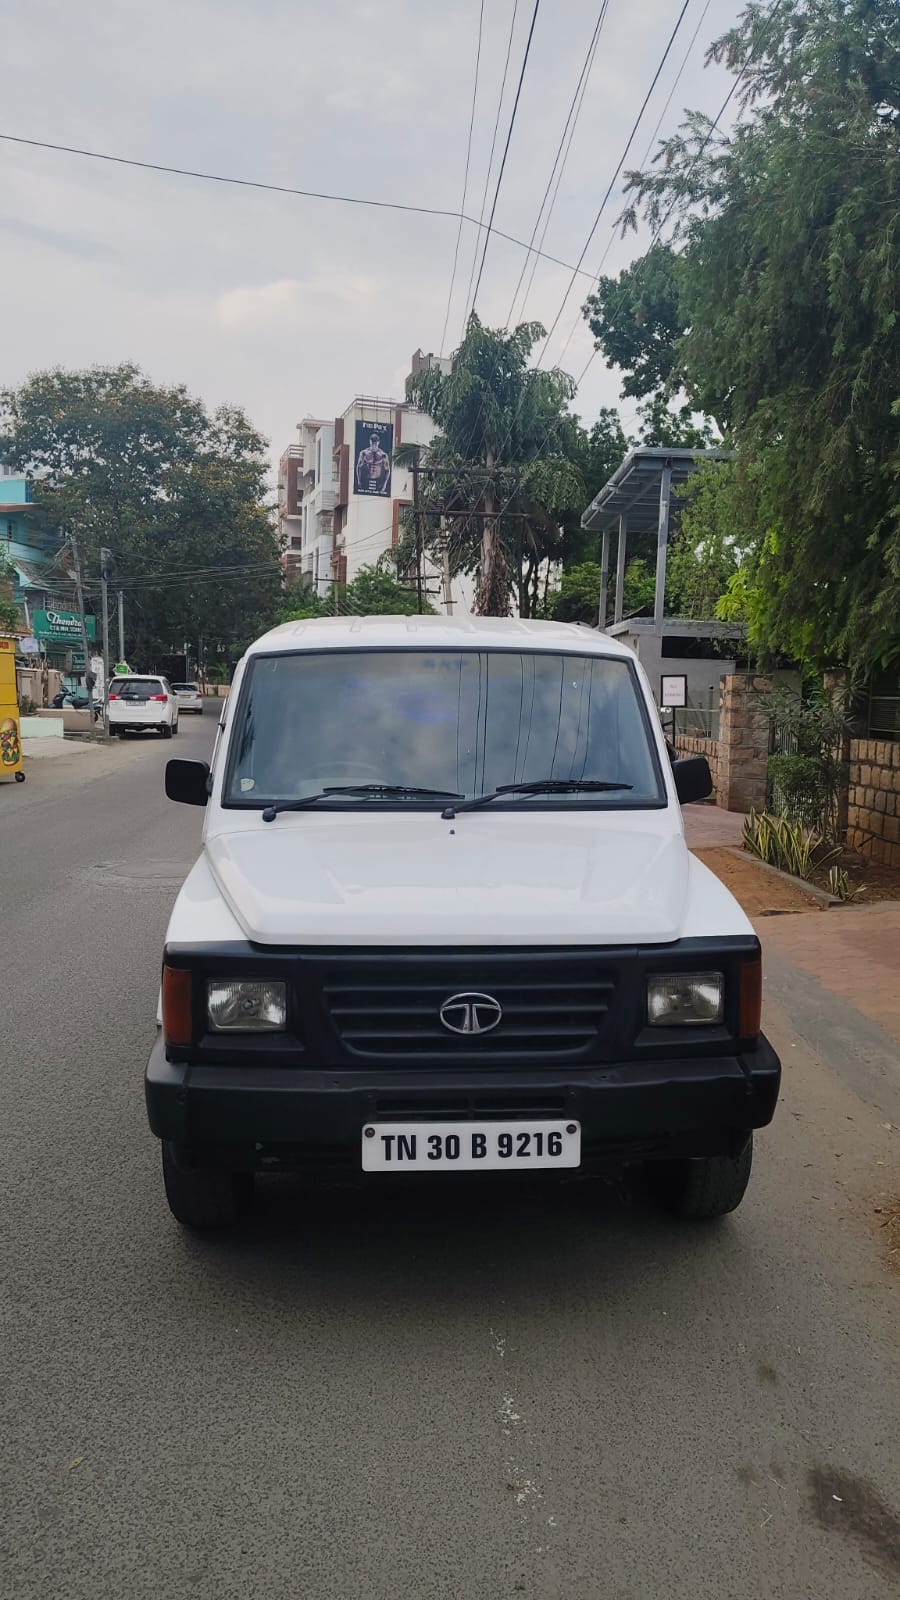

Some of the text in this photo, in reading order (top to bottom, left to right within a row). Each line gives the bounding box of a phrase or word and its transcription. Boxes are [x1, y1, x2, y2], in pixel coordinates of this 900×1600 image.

[381, 1131, 563, 1161] TN 30 B 9216
